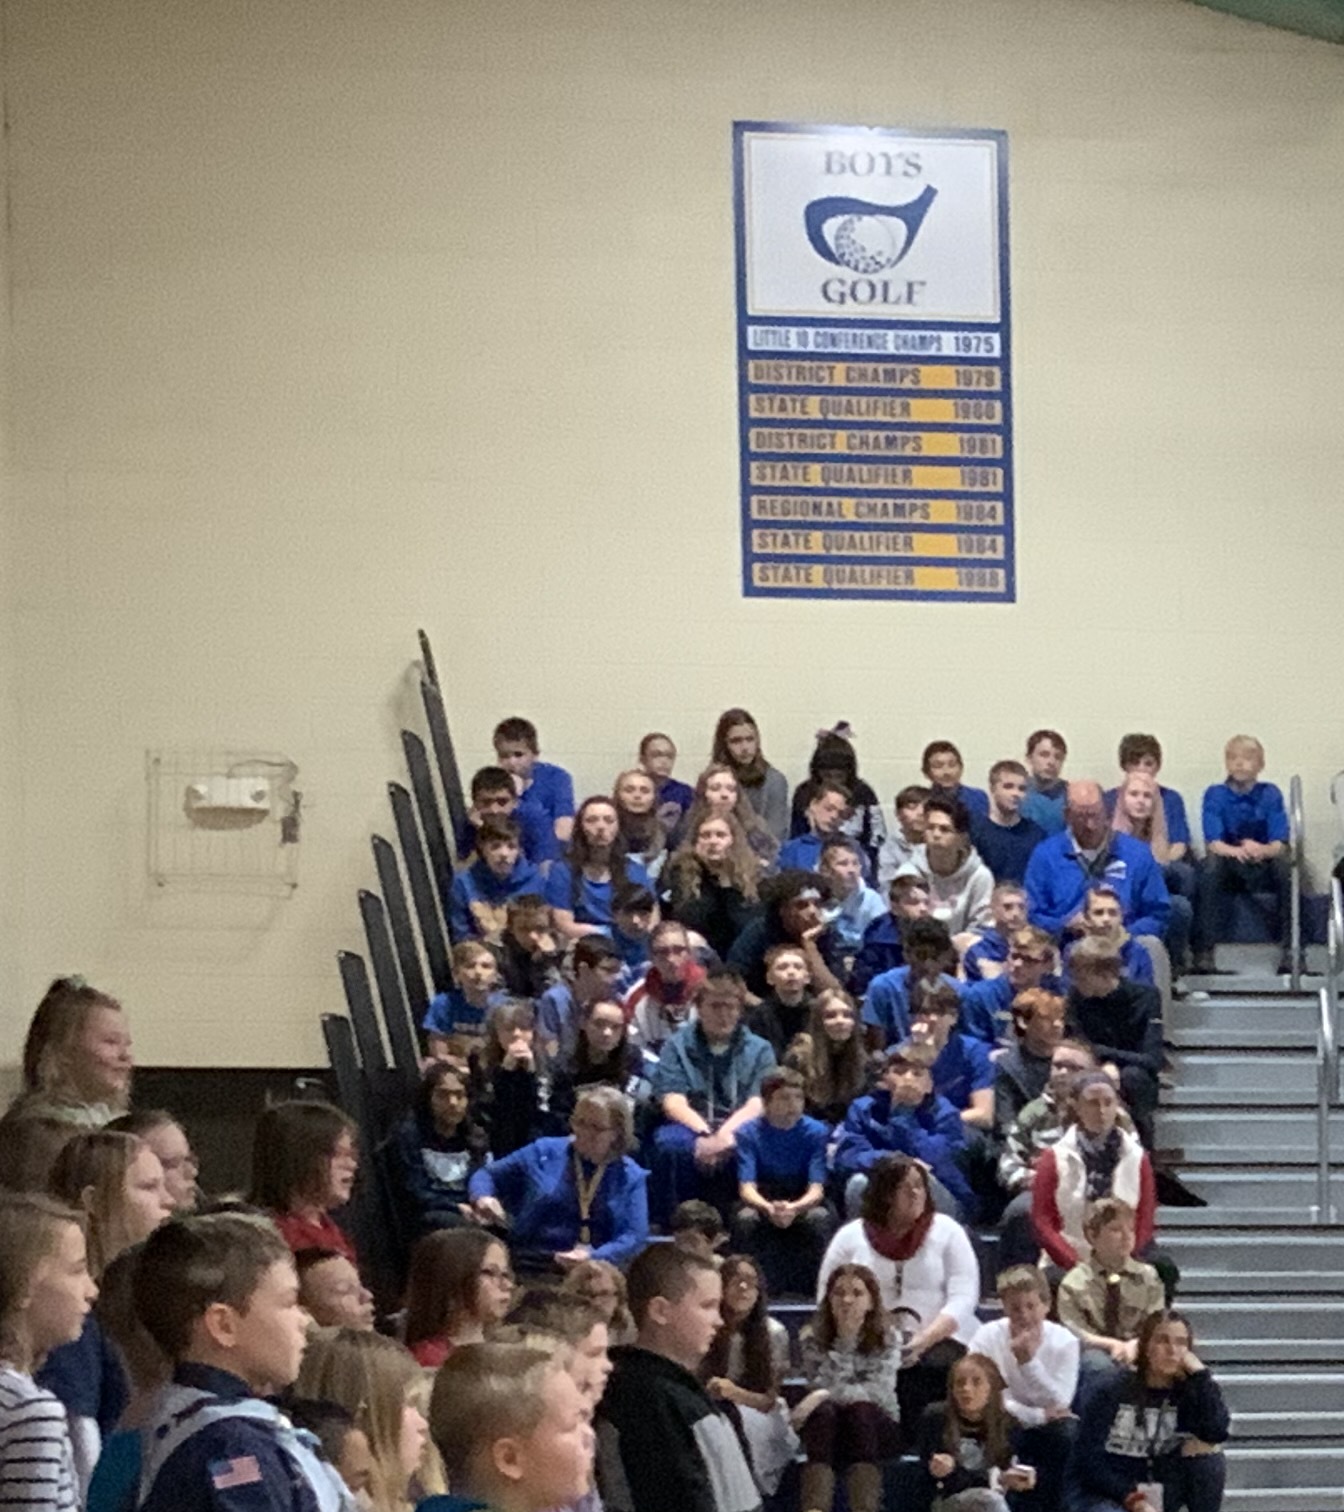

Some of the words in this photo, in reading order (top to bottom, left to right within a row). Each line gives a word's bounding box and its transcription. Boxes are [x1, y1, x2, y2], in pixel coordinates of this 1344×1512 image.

[823, 150, 923, 178] BOYS
[821, 277, 926, 305] GOLF
[954, 335, 995, 354] 1975
[753, 363, 837, 384] DISTRICT
[845, 365, 922, 386] CHAMPS
[955, 368, 996, 387] 1979
[753, 396, 809, 416] STATE
[819, 398, 912, 419] QUALIFIER
[755, 430, 838, 450] DISTRICT
[846, 432, 923, 453] CHAMPS
[755, 463, 810, 483] STATE
[820, 464, 913, 486] QUALIFIER
[959, 469, 998, 488] 1981
[756, 497, 846, 518] REGIONAL
[854, 499, 931, 520] CHAMPS
[757, 531, 813, 551] STATE
[822, 533, 914, 555] QUALIFIER
[757, 565, 814, 584] STATE
[822, 567, 915, 588] QUALIFIER
